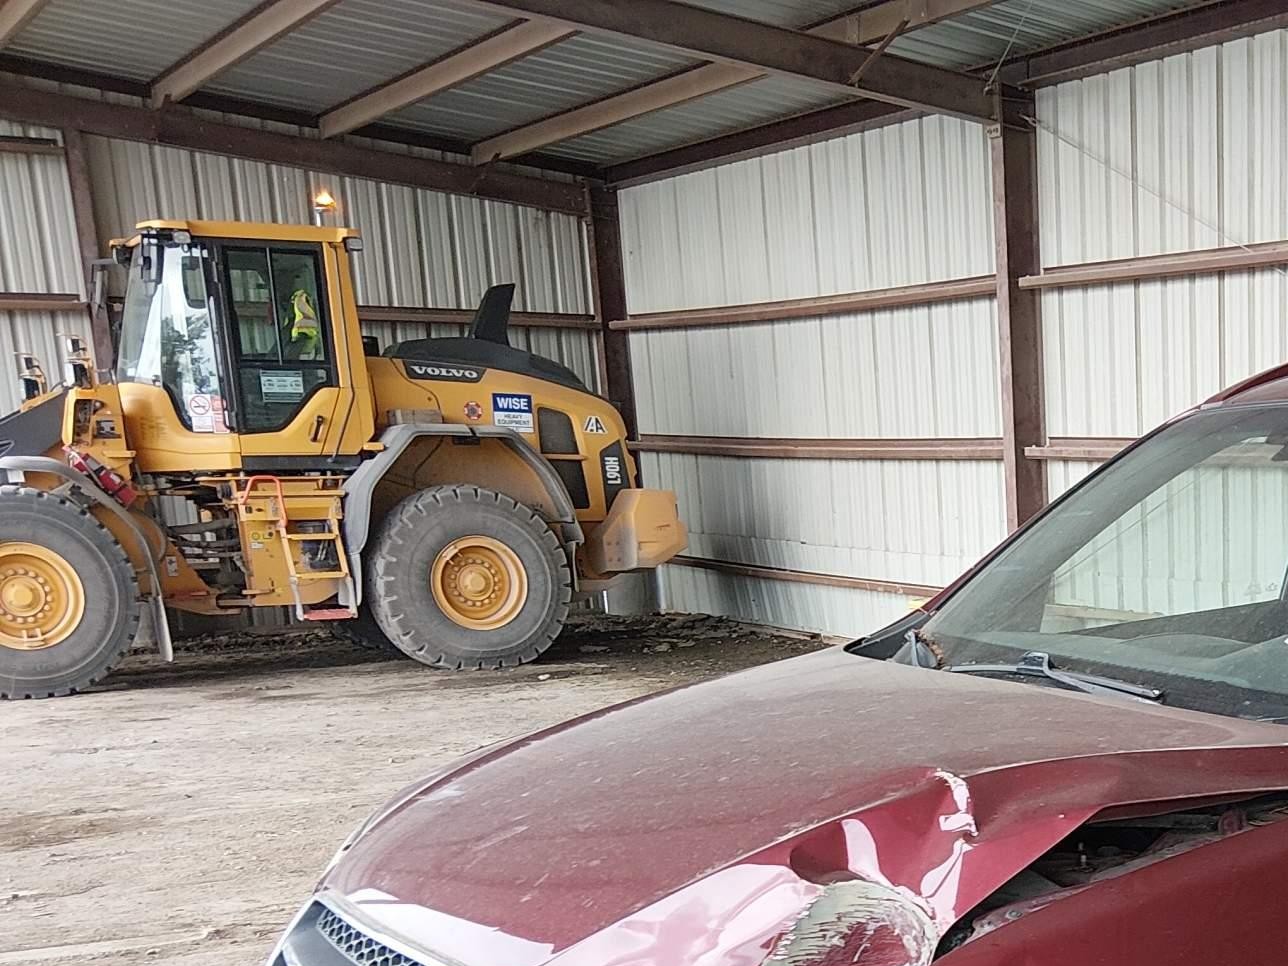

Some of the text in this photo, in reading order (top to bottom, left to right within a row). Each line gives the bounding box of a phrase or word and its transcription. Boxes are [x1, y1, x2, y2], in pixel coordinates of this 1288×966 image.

[410, 365, 478, 379] VOLVO
[496, 397, 529, 410] WISE
[604, 456, 622, 485] L90H
